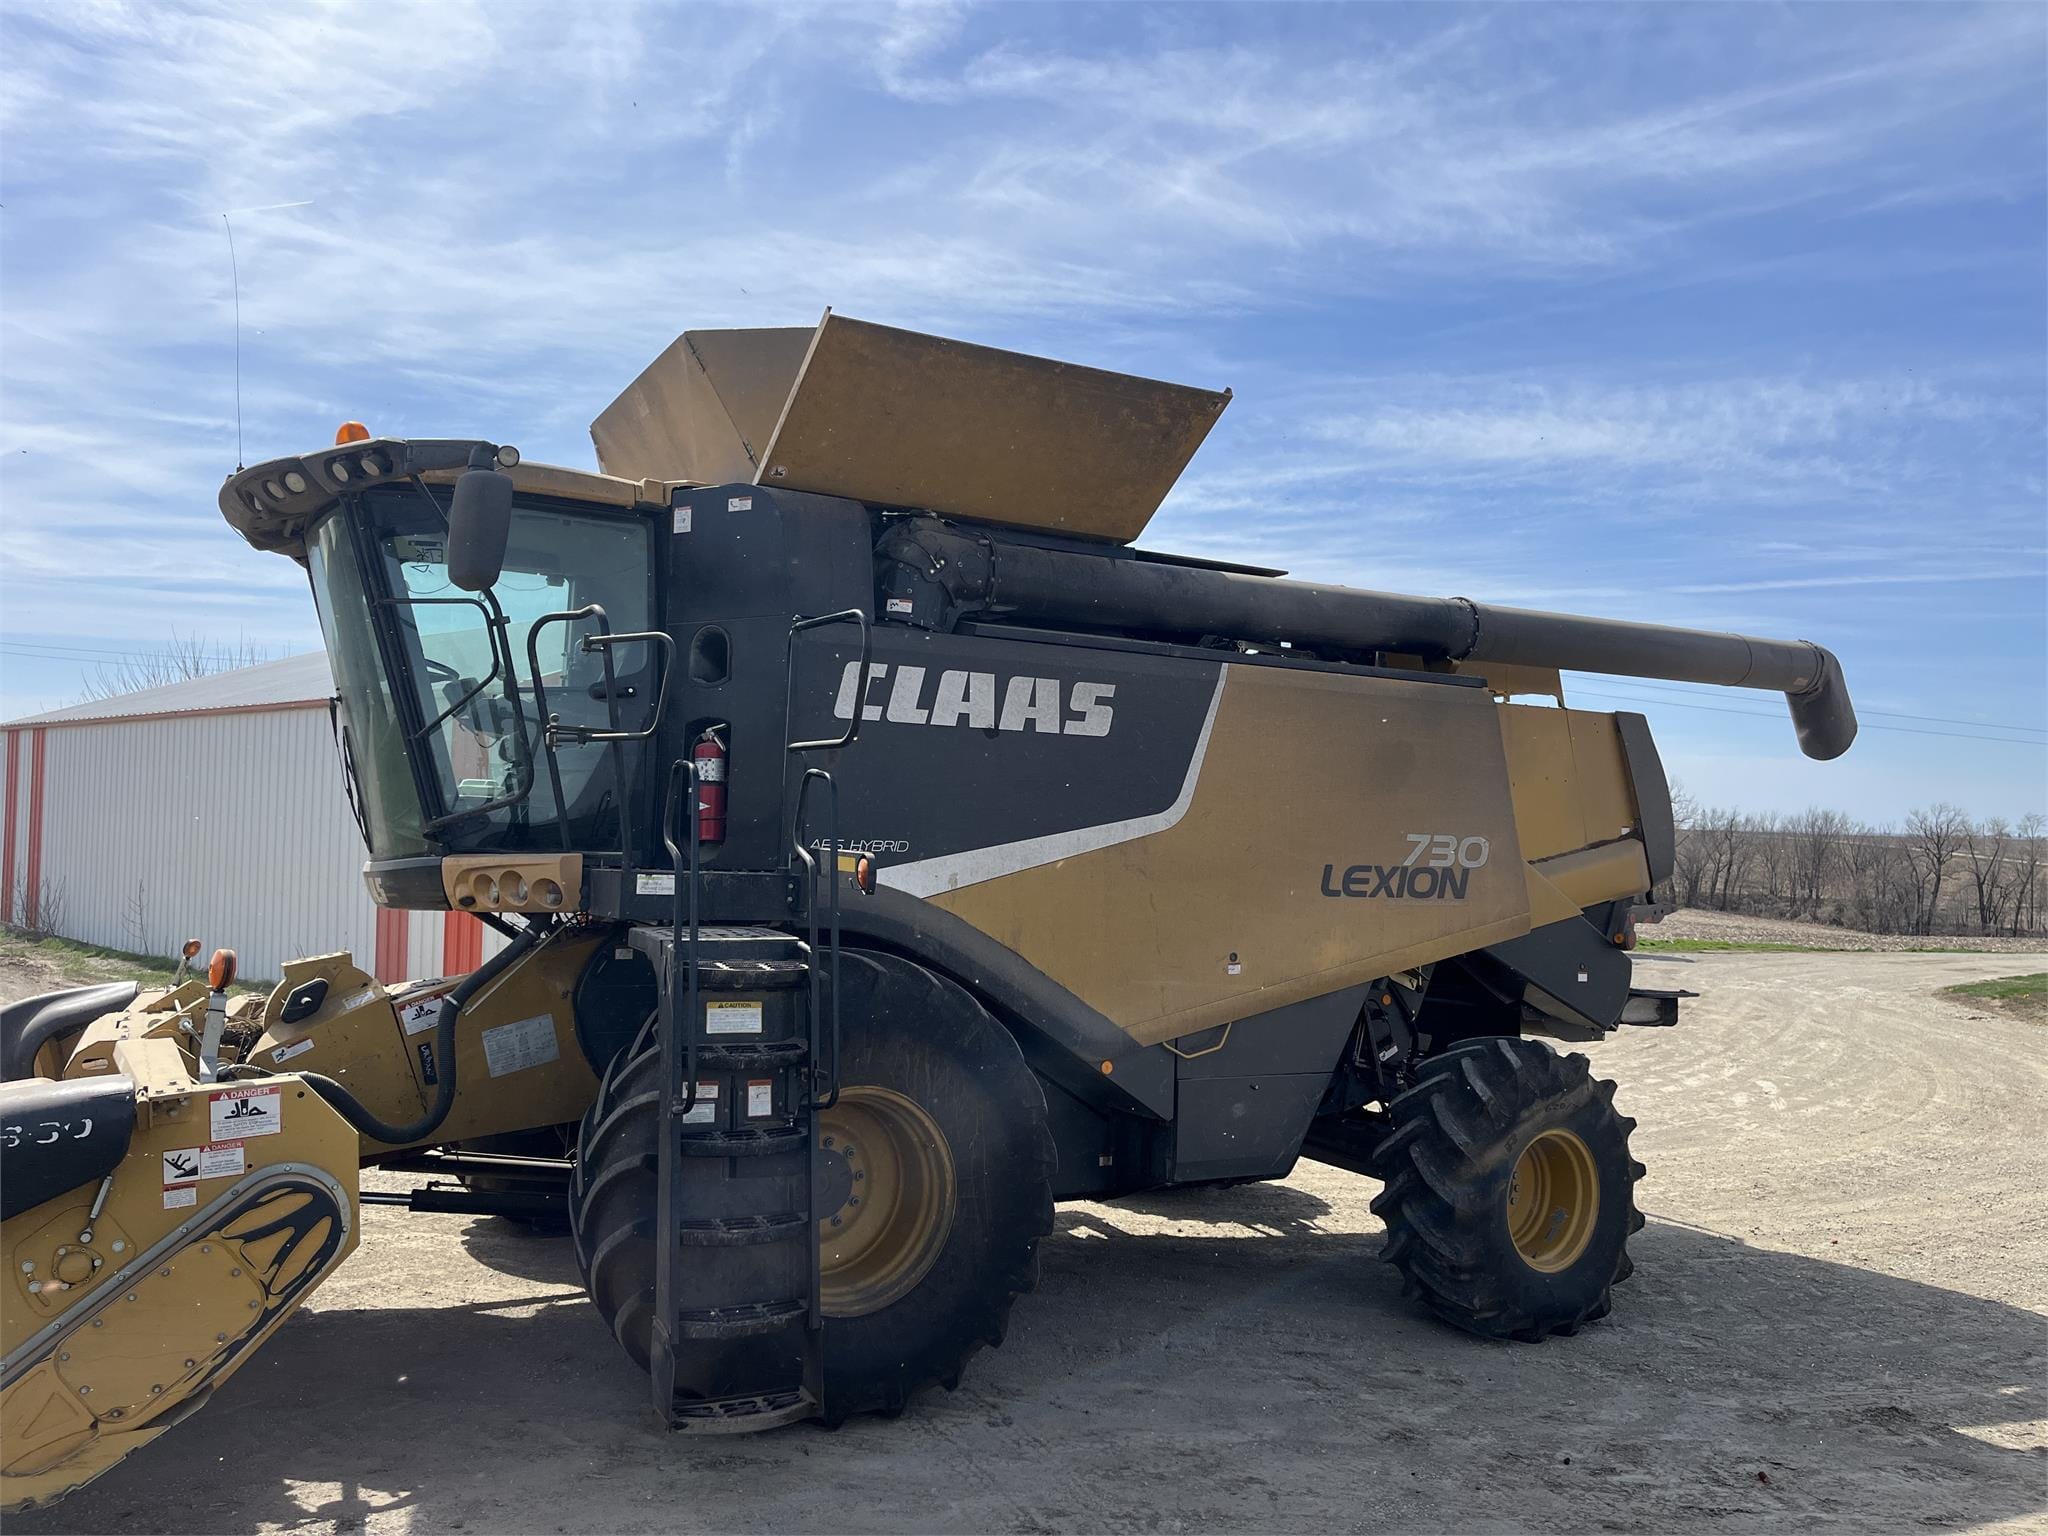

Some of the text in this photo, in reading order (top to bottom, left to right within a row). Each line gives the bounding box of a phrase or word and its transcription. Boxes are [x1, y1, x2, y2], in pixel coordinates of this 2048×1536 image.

[834, 661, 1116, 737] CLAAS
[850, 839, 909, 853] HYBRID
[1403, 834, 1489, 868] 730
[1321, 864, 1470, 899] LEXION
[230, 1088, 270, 1099] DANGER
[212, 1141, 242, 1151] DANGER
